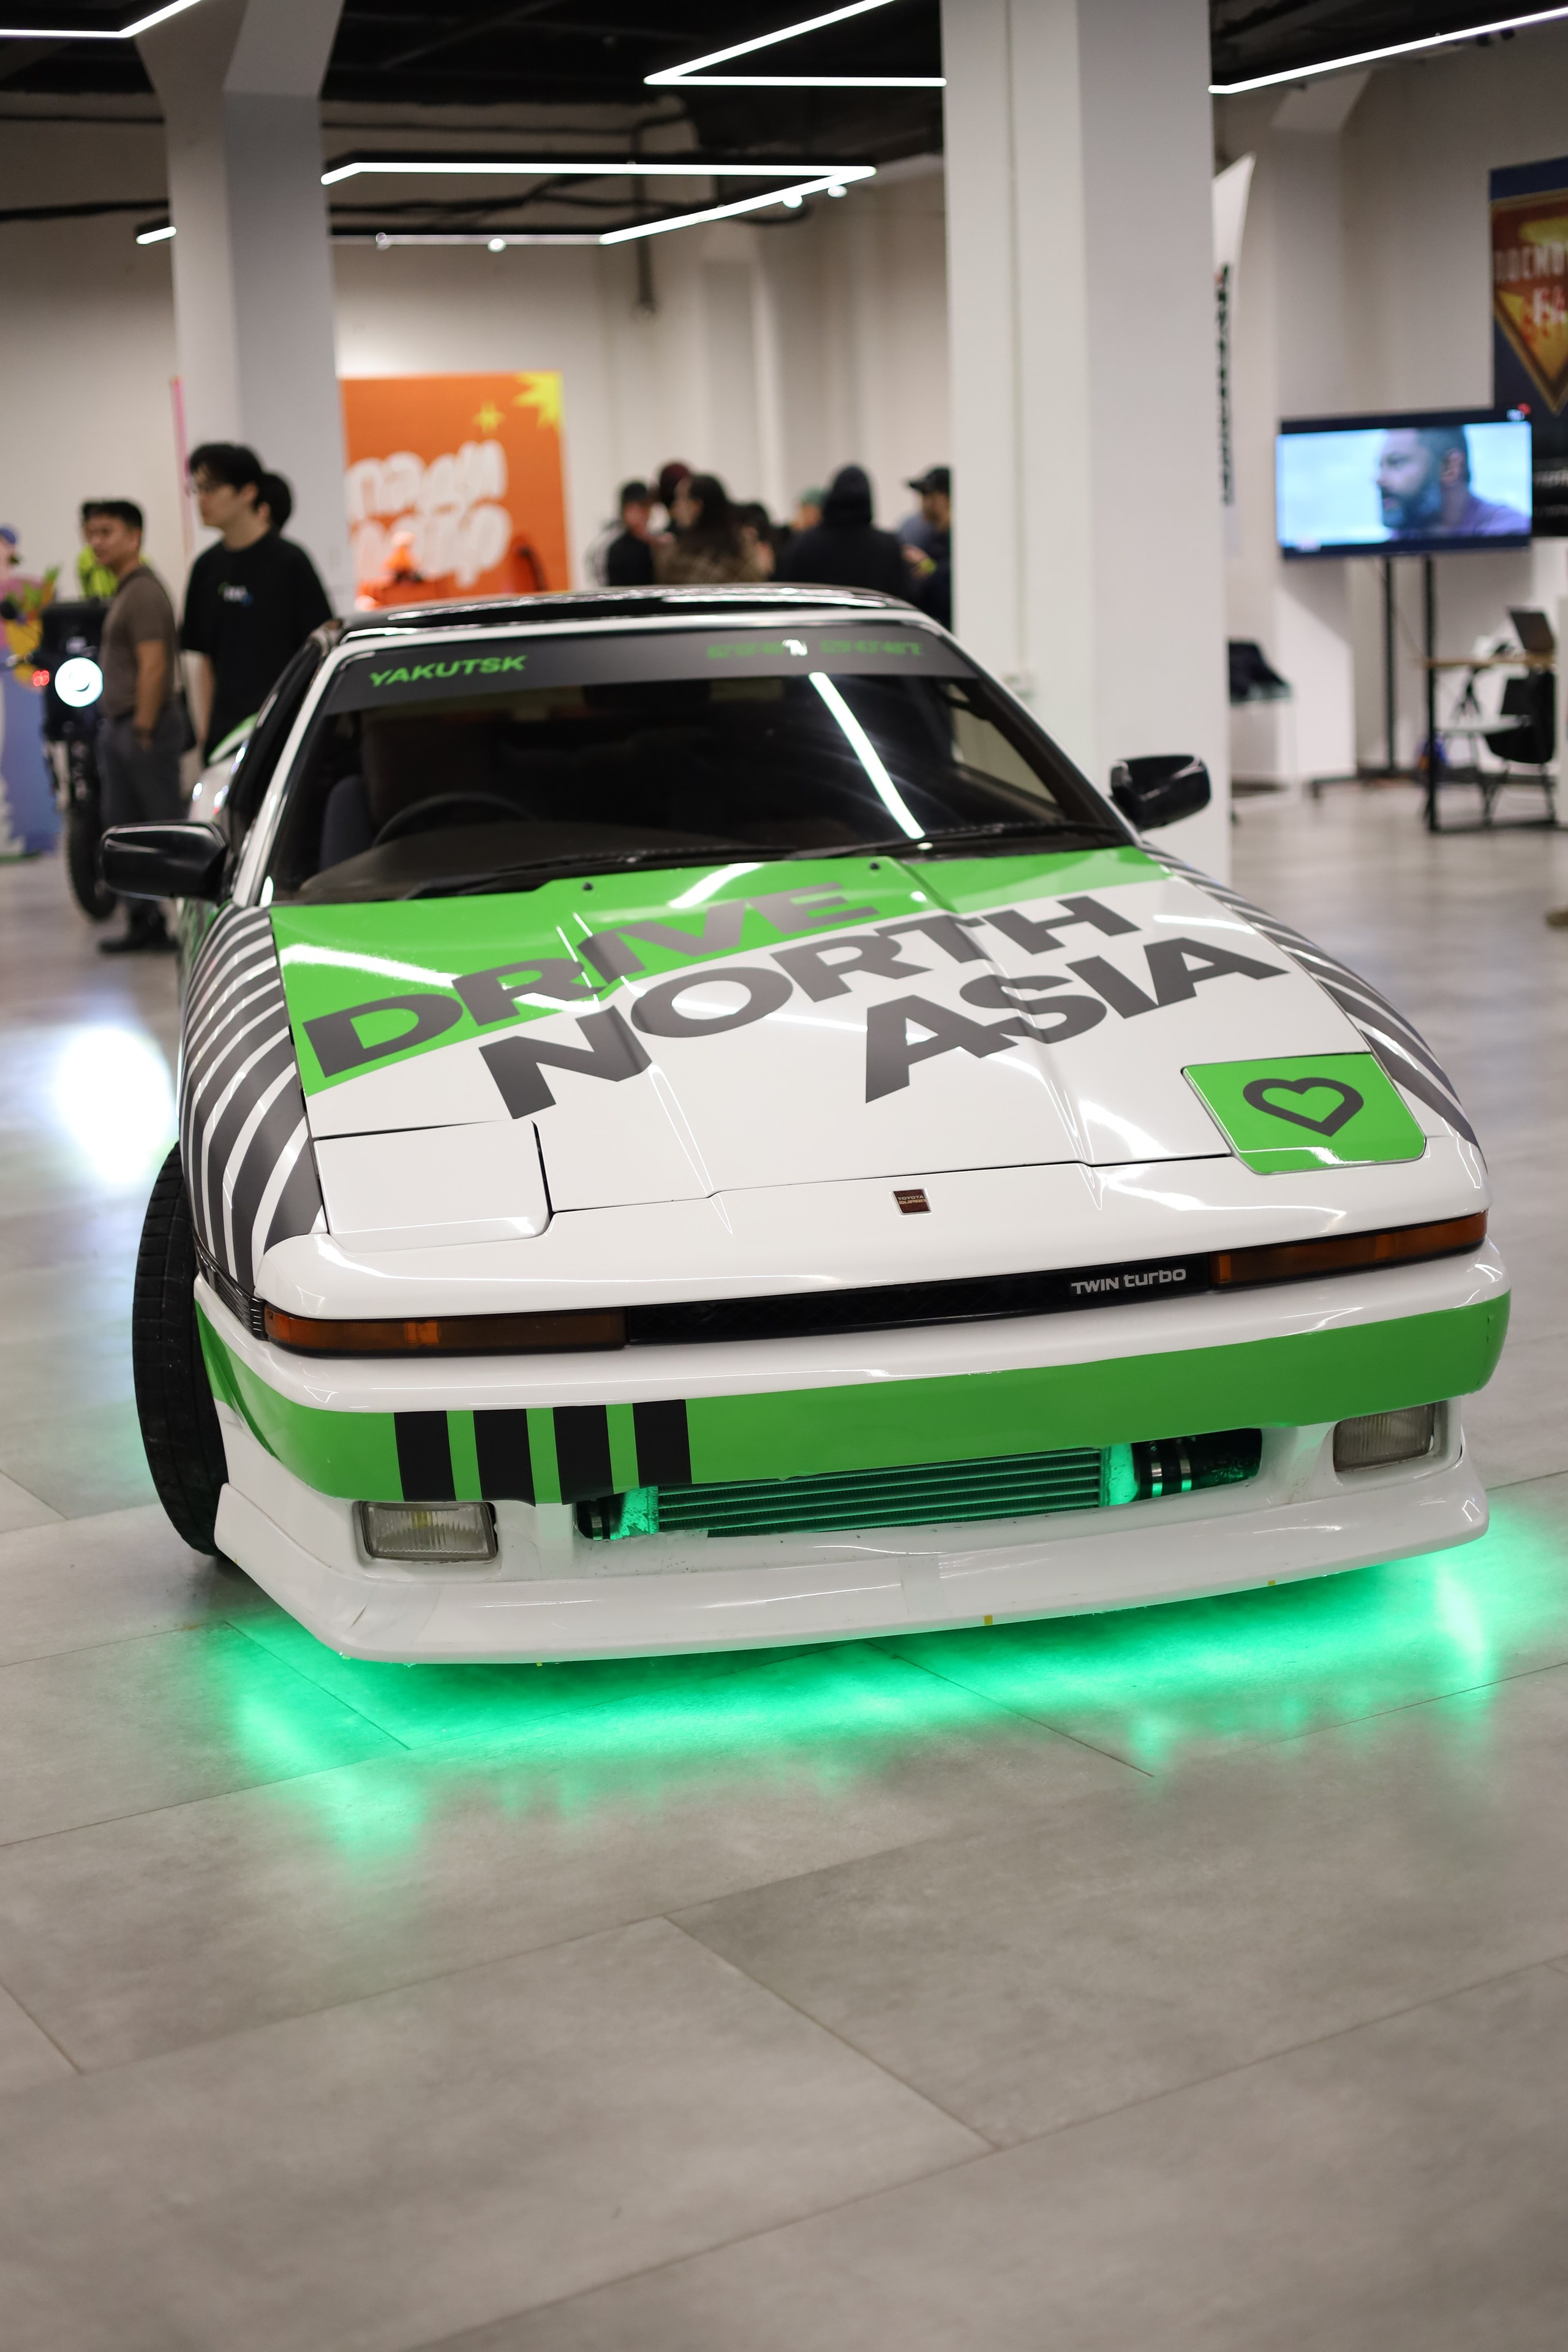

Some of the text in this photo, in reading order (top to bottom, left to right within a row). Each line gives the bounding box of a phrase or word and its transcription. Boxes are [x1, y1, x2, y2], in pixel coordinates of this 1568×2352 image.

[369, 655, 527, 687] YAKUTSK
[303, 881, 880, 1078] DRIVE
[478, 895, 1142, 1120] NORTH
[865, 937, 1291, 1104] ASIA
[1071, 1268, 1186, 1294] TWIN turbo
